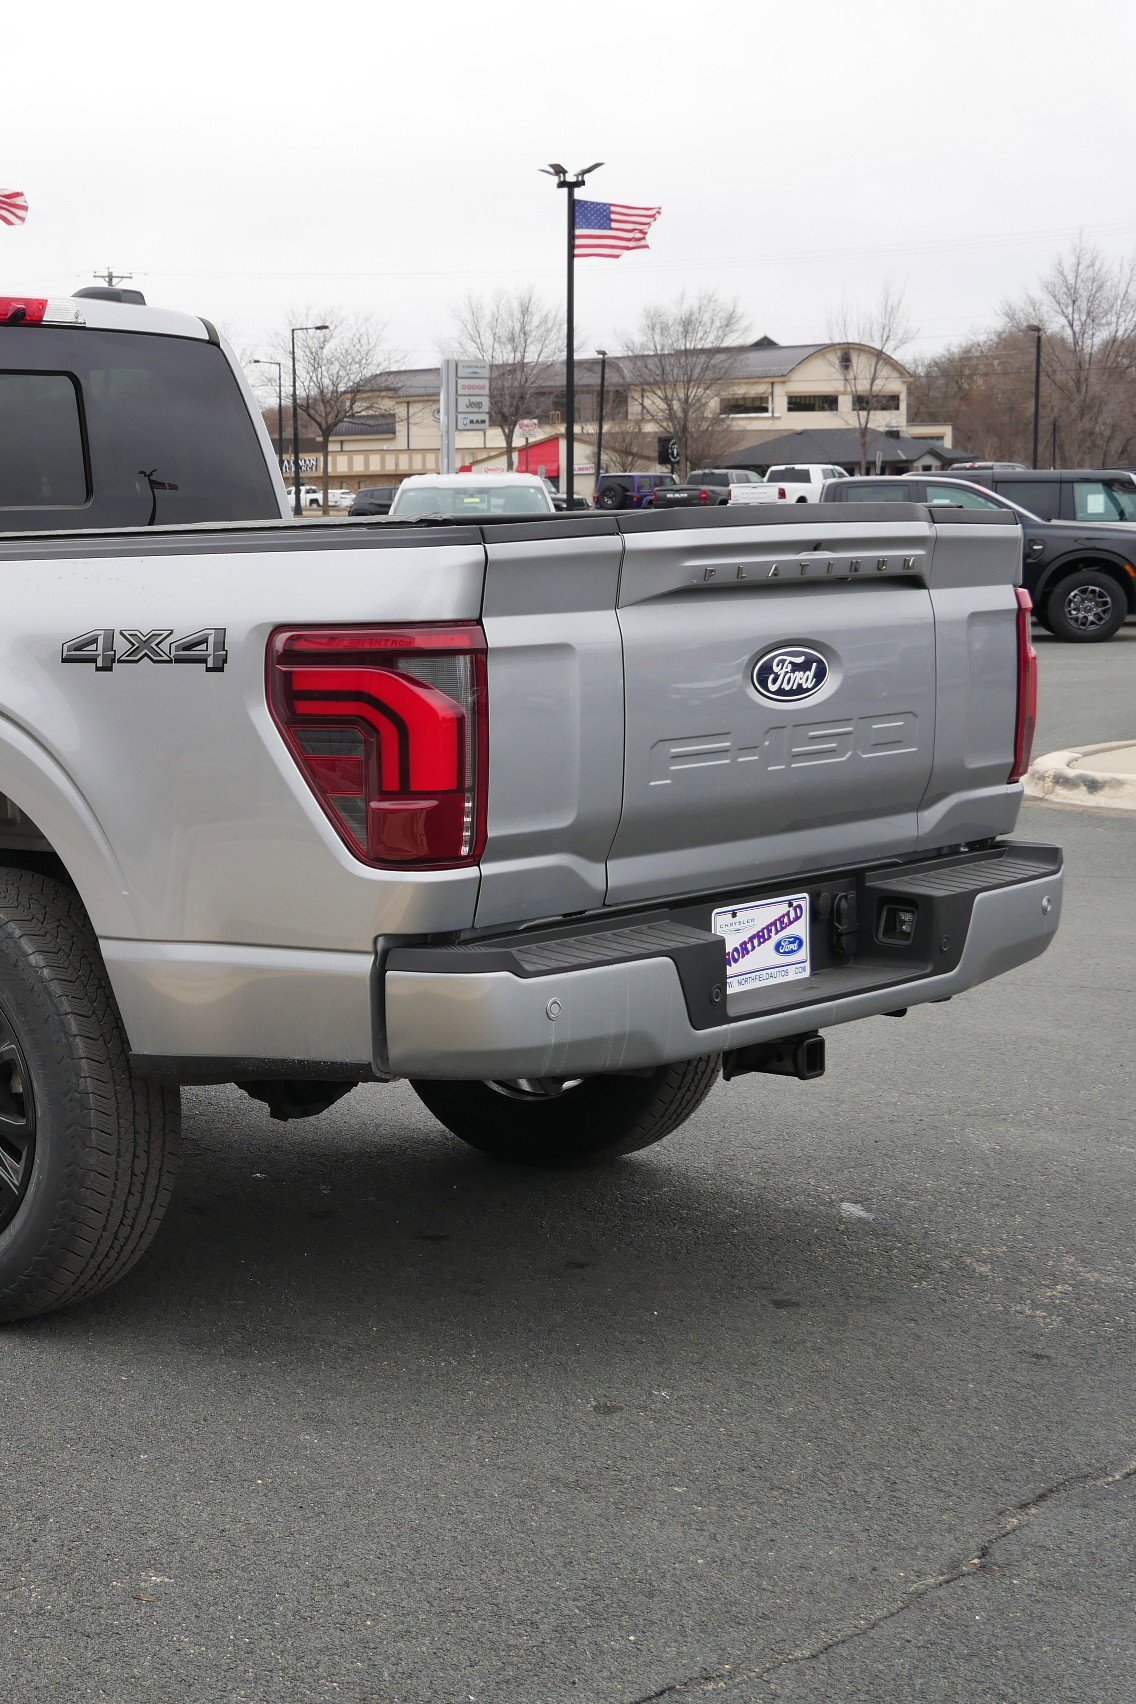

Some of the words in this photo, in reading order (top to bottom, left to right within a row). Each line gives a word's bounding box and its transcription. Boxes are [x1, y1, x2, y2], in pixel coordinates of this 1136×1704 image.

[466, 398, 483, 410] Jeep
[704, 556, 915, 581] PLATINUM
[768, 654, 818, 692] Ford
[649, 711, 918, 786] F-150
[719, 918, 756, 929] CHRYSLER
[779, 937, 799, 953] Ford
